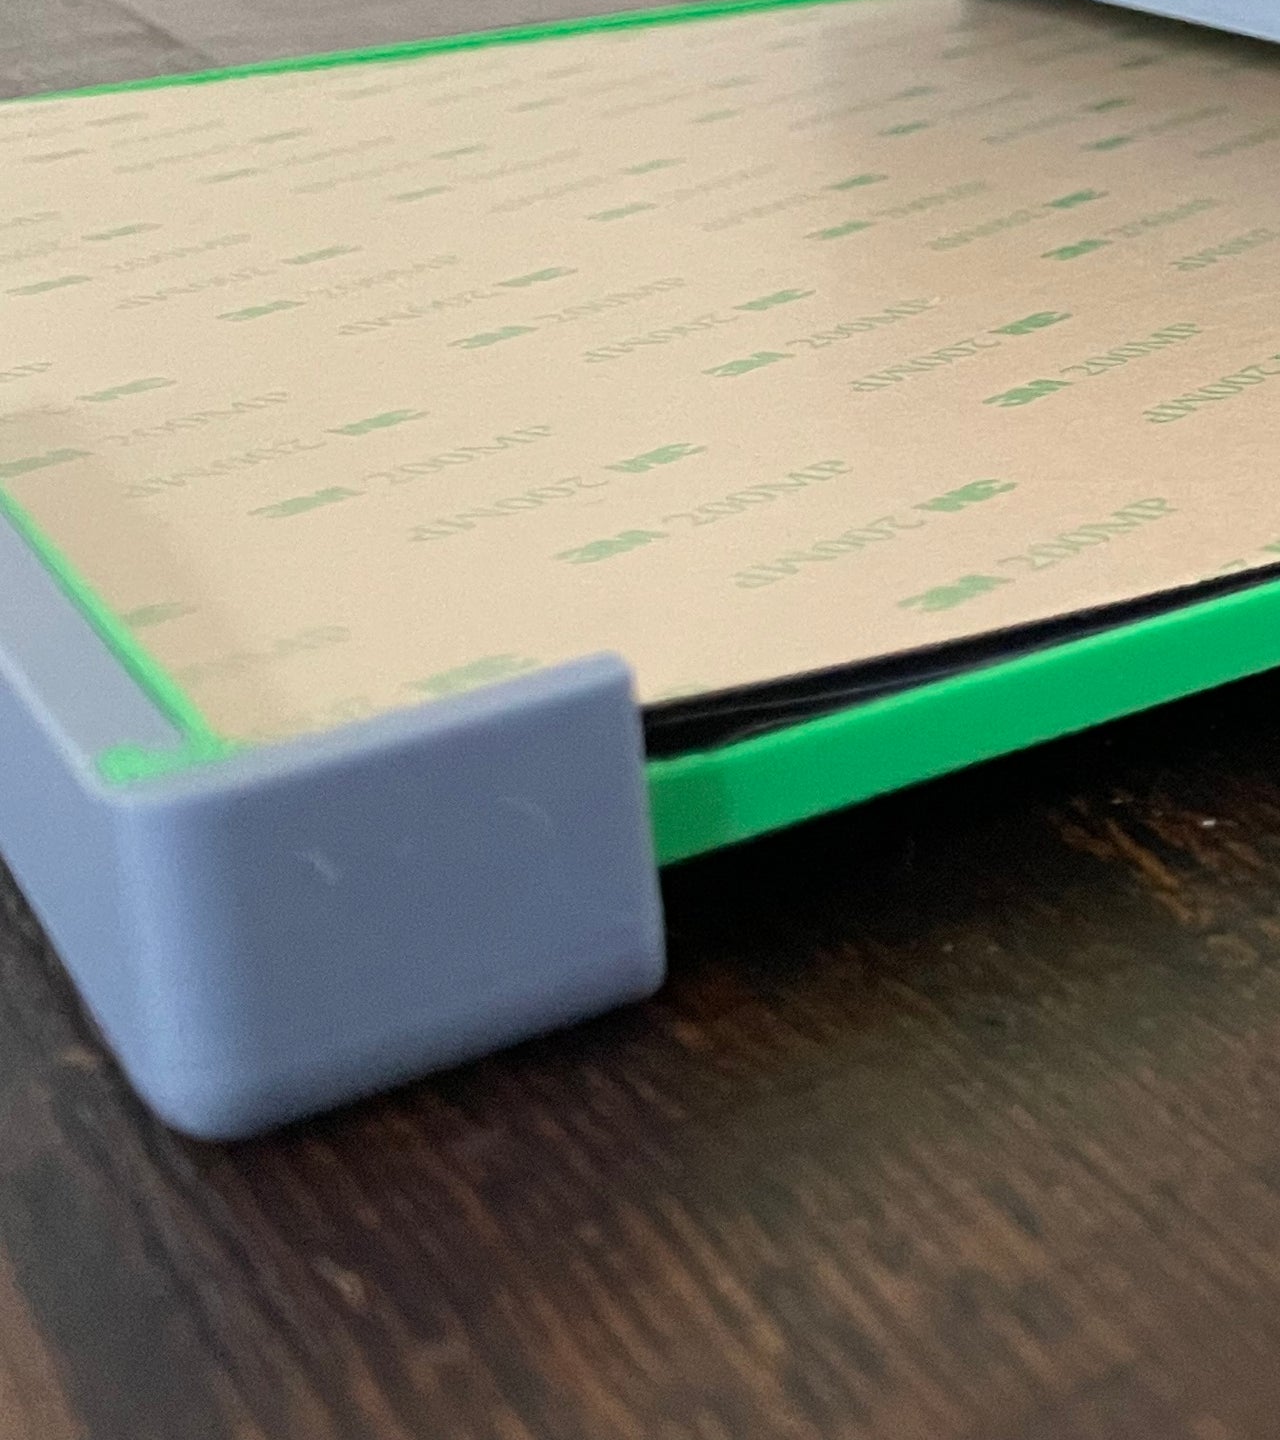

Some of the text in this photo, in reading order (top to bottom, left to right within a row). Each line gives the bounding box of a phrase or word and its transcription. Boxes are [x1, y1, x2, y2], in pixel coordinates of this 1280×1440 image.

[702, 298, 934, 377] 3M 200MP
[848, 312, 1072, 392] 3M 200MP
[983, 323, 1203, 407] 3M 200MP
[247, 424, 552, 519] 3M 200MP
[407, 443, 706, 542] 3M 200MP
[555, 459, 853, 564] 3M 200MP
[731, 479, 1018, 589] 3M 200MP
[896, 497, 1179, 612] 3M 200MP
